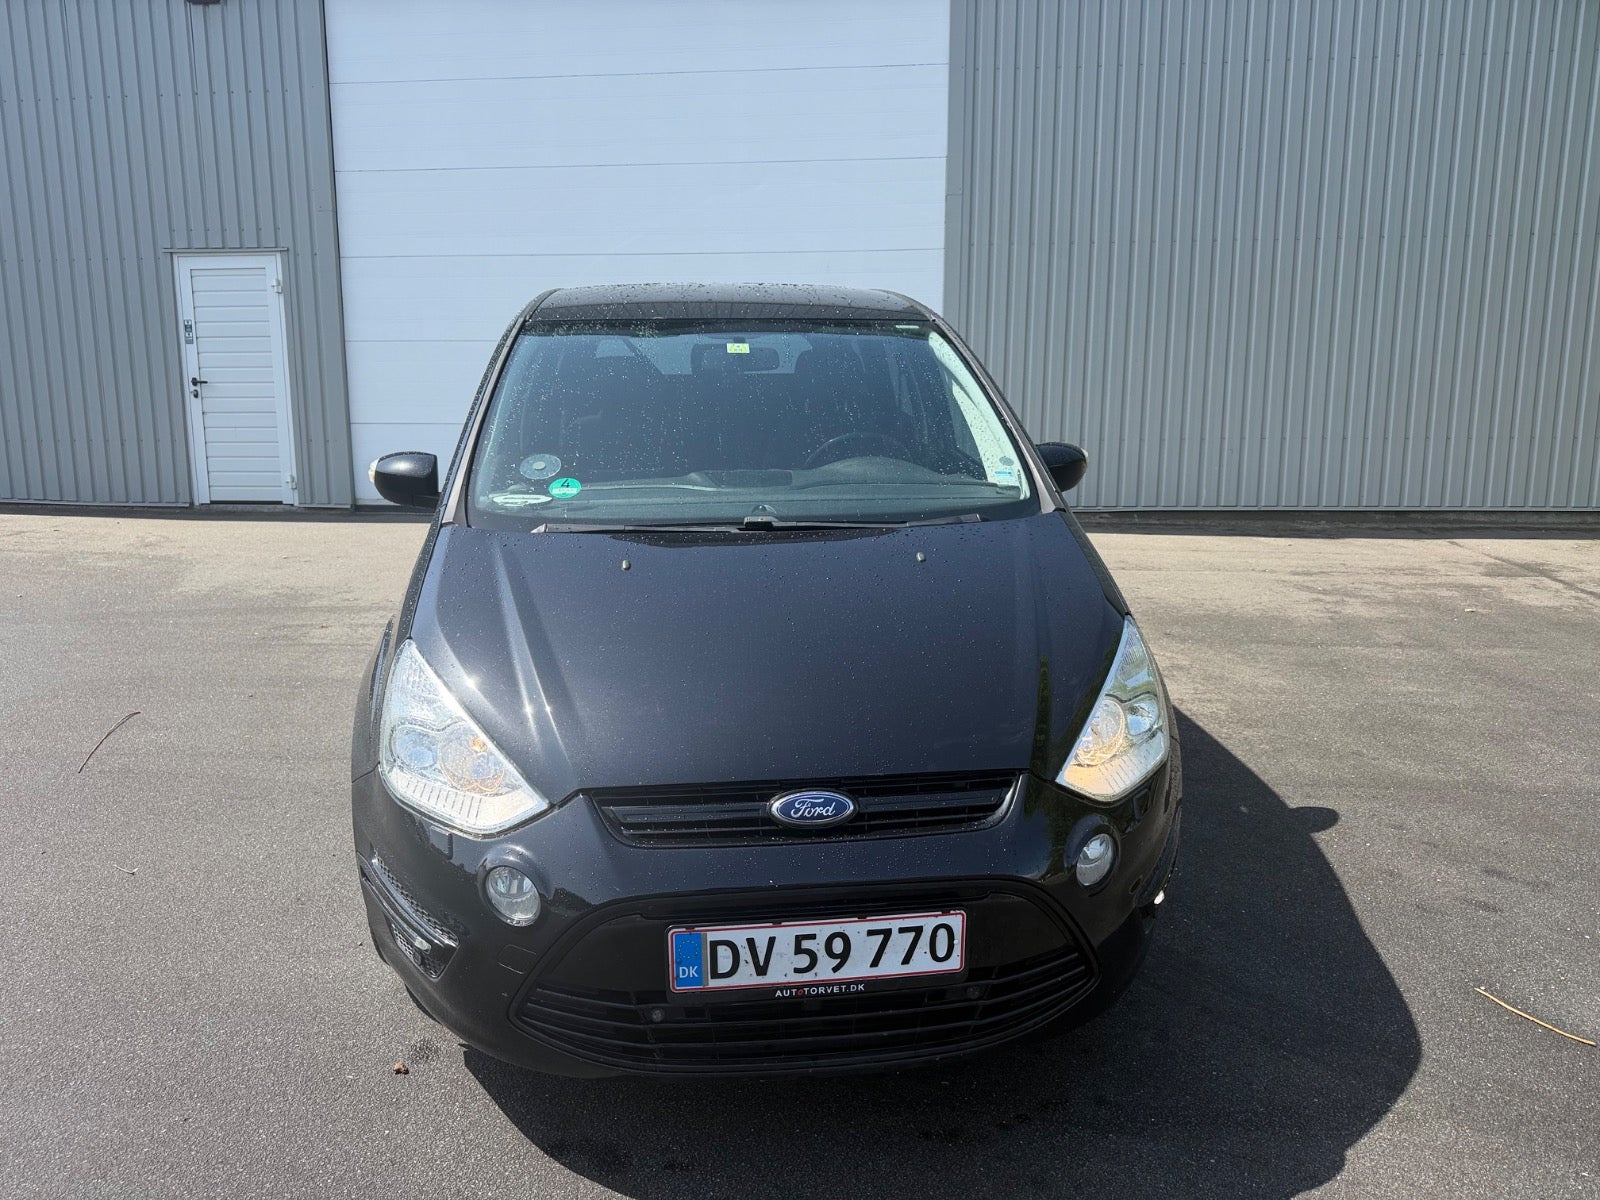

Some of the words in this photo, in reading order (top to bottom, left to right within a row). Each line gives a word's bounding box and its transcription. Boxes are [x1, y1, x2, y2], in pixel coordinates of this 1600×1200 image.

[560, 479, 570, 488] 4
[790, 798, 836, 818] Ford
[709, 936, 776, 979] DV
[793, 931, 852, 974] 59
[866, 923, 955, 968] 770
[679, 965, 698, 978] DK
[775, 983, 865, 997] AUTOTORVET.DK
